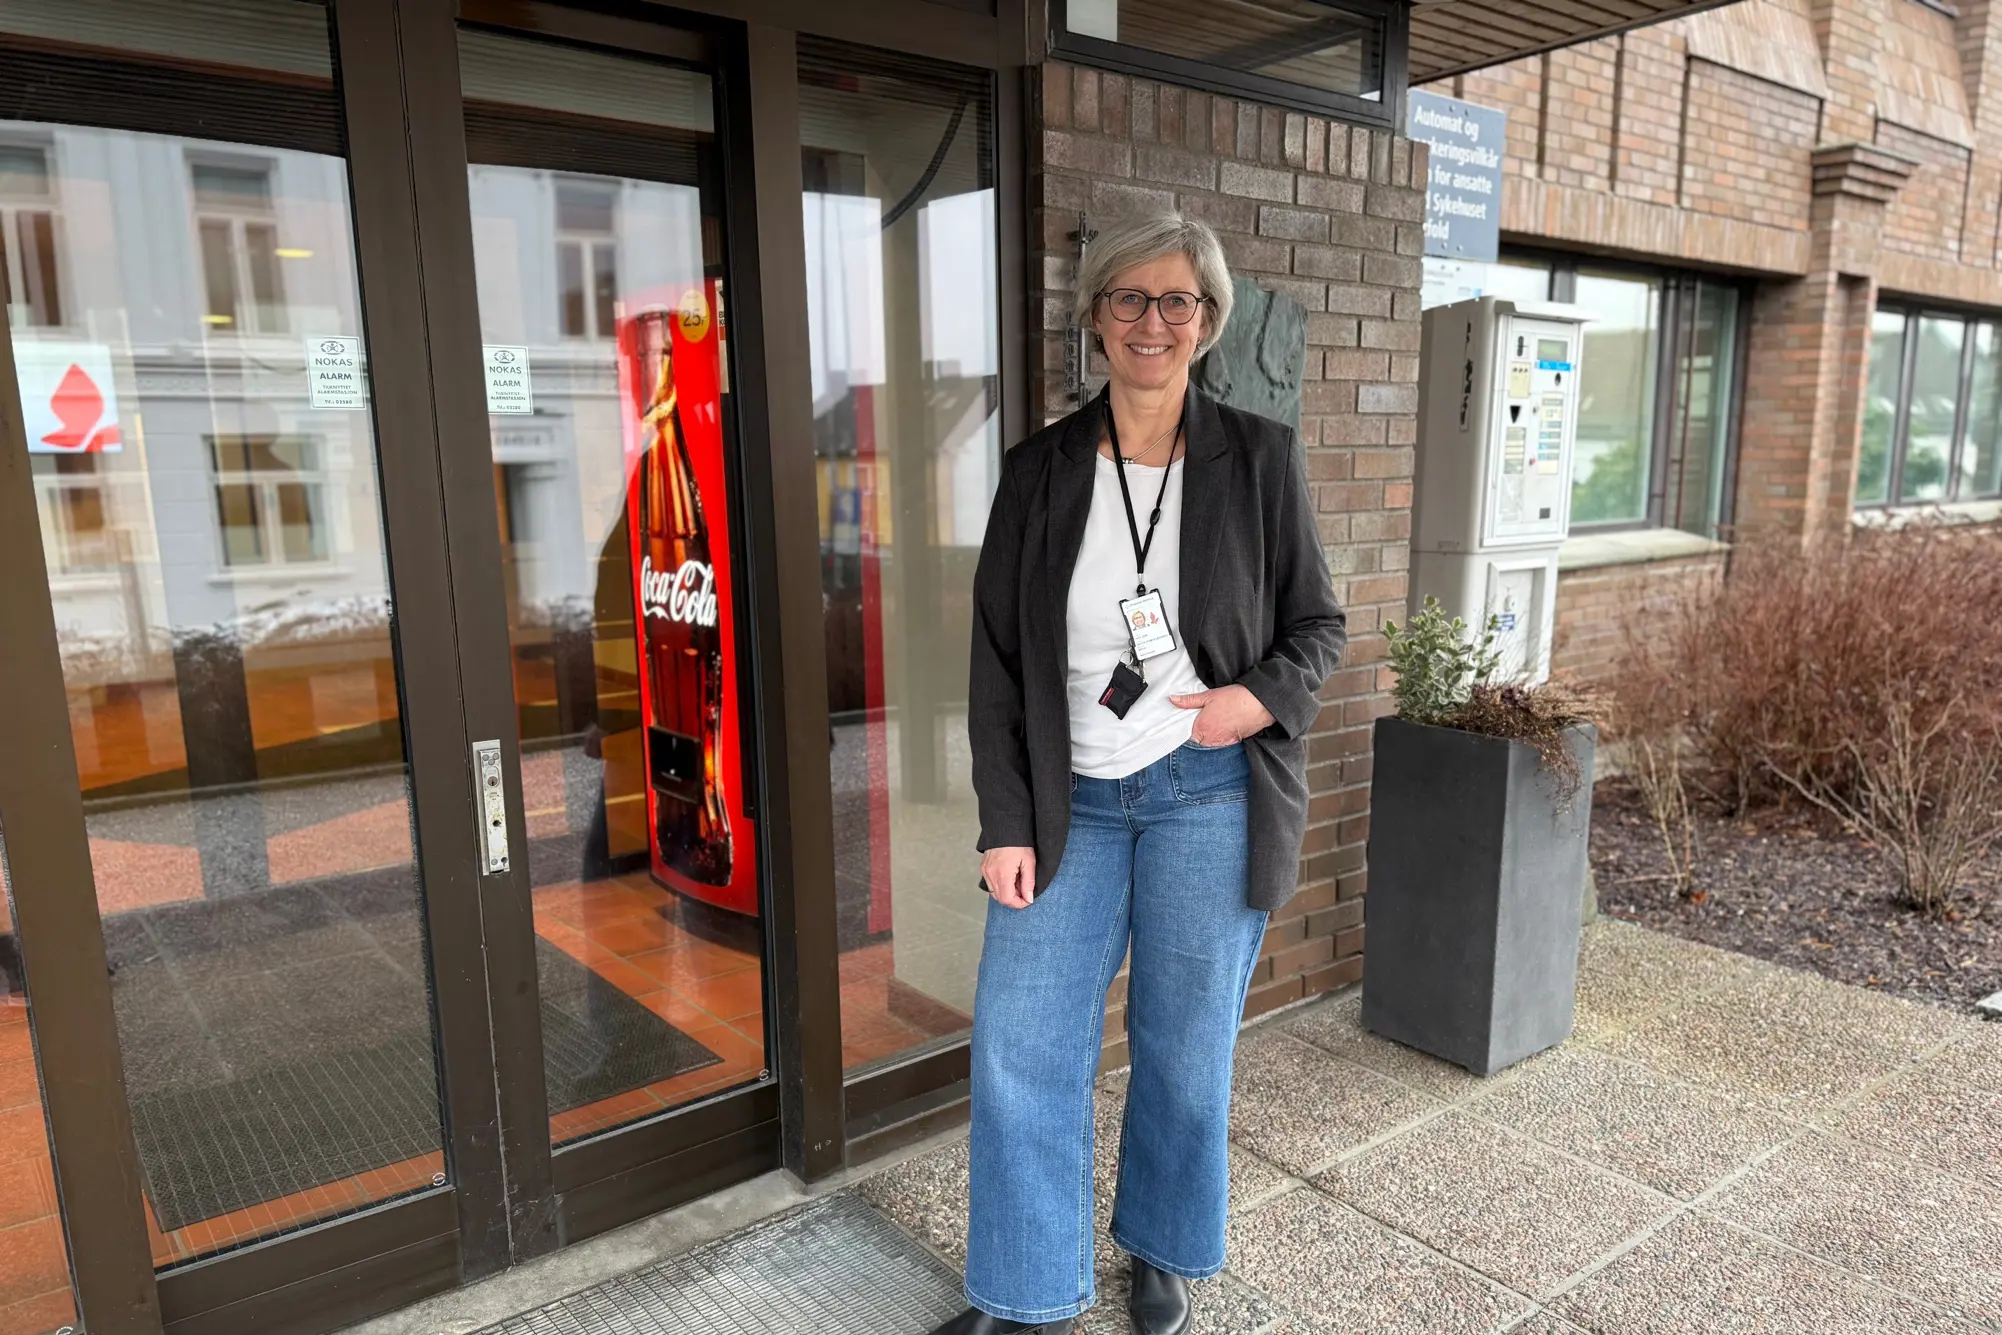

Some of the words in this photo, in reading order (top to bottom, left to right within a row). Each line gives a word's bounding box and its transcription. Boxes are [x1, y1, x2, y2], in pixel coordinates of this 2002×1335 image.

[1414, 105, 1463, 134] Automat
[1464, 121, 1480, 143] og
[1414, 136, 1499, 169] keringsvilkår
[1434, 164, 1452, 186] for
[1453, 172, 1493, 195] ansatte
[1433, 193, 1487, 220] Sykehuset
[315, 357, 353, 367] NOKAS
[489, 366, 522, 375] NOKAS
[320, 372, 353, 380] ALARM
[493, 379, 521, 387] ALARM
[641, 556, 718, 627] Coca-Cola
